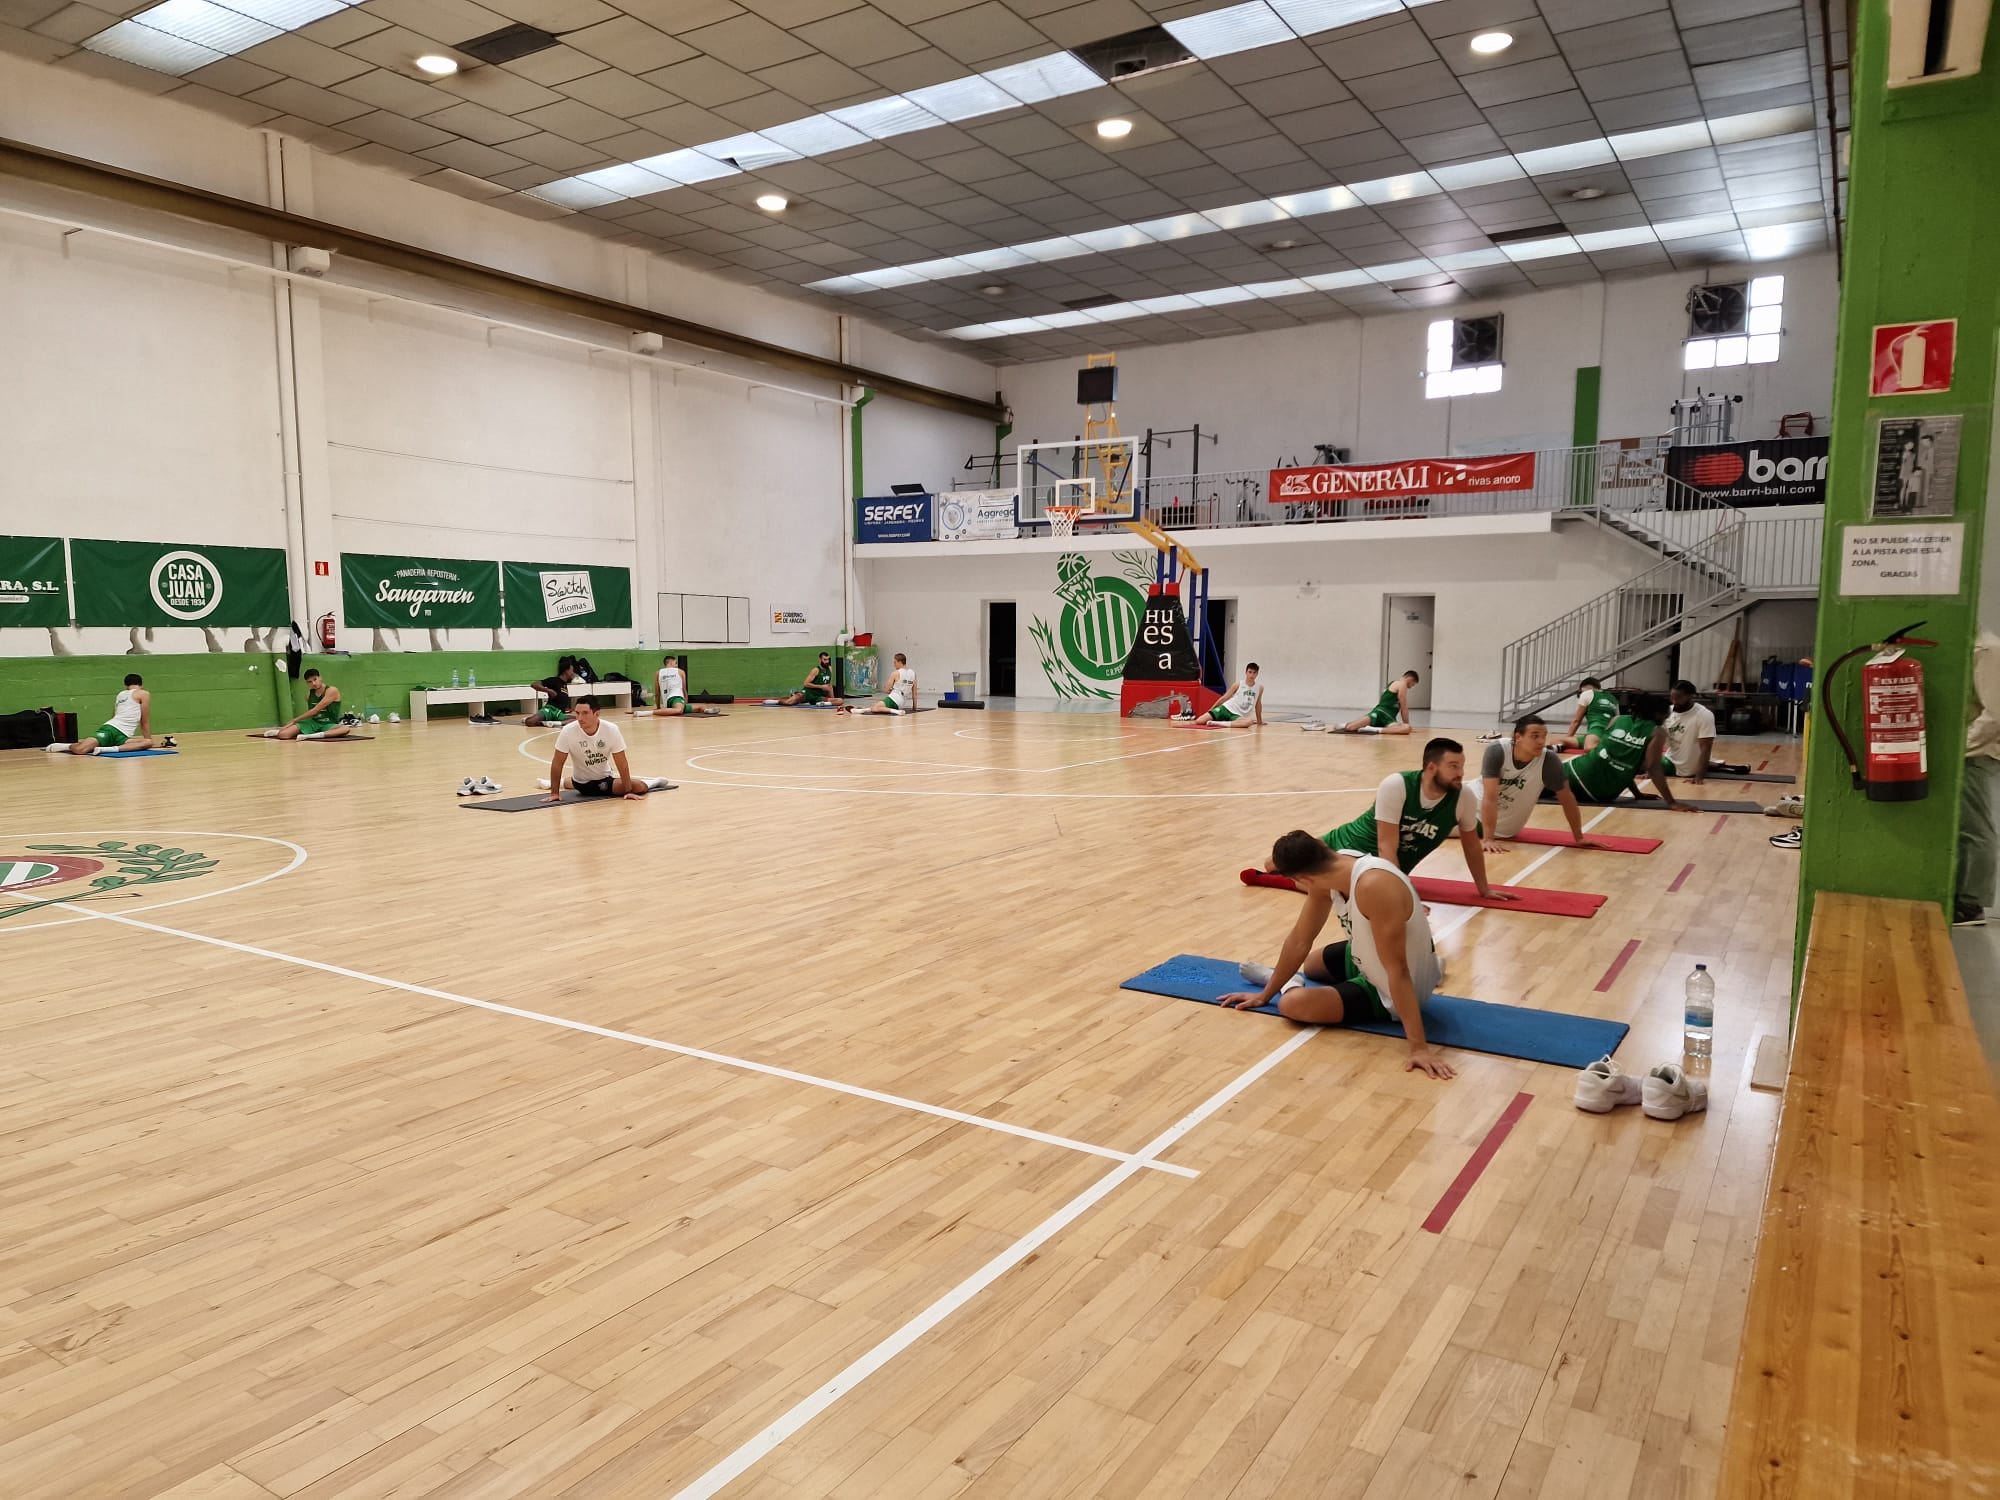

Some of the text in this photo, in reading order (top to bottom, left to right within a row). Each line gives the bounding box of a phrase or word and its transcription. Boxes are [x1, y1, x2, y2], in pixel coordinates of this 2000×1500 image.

[1748, 449, 1829, 483] barr
[1312, 465, 1430, 494] GENERALI
[1468, 476, 1491, 486] rivas
[1701, 485, 1816, 498] www.barri-ball.com
[864, 503, 924, 521] SERFEY
[1860, 548, 1871, 556] LA
[168, 563, 204, 581] CASA
[0, 580, 60, 593] RA, S.L.
[167, 580, 206, 599] JUAN
[545, 576, 590, 598] Switch
[375, 580, 475, 618] Sangarrén
[556, 602, 587, 614] Idiomas
[1143, 625, 1174, 645] es
